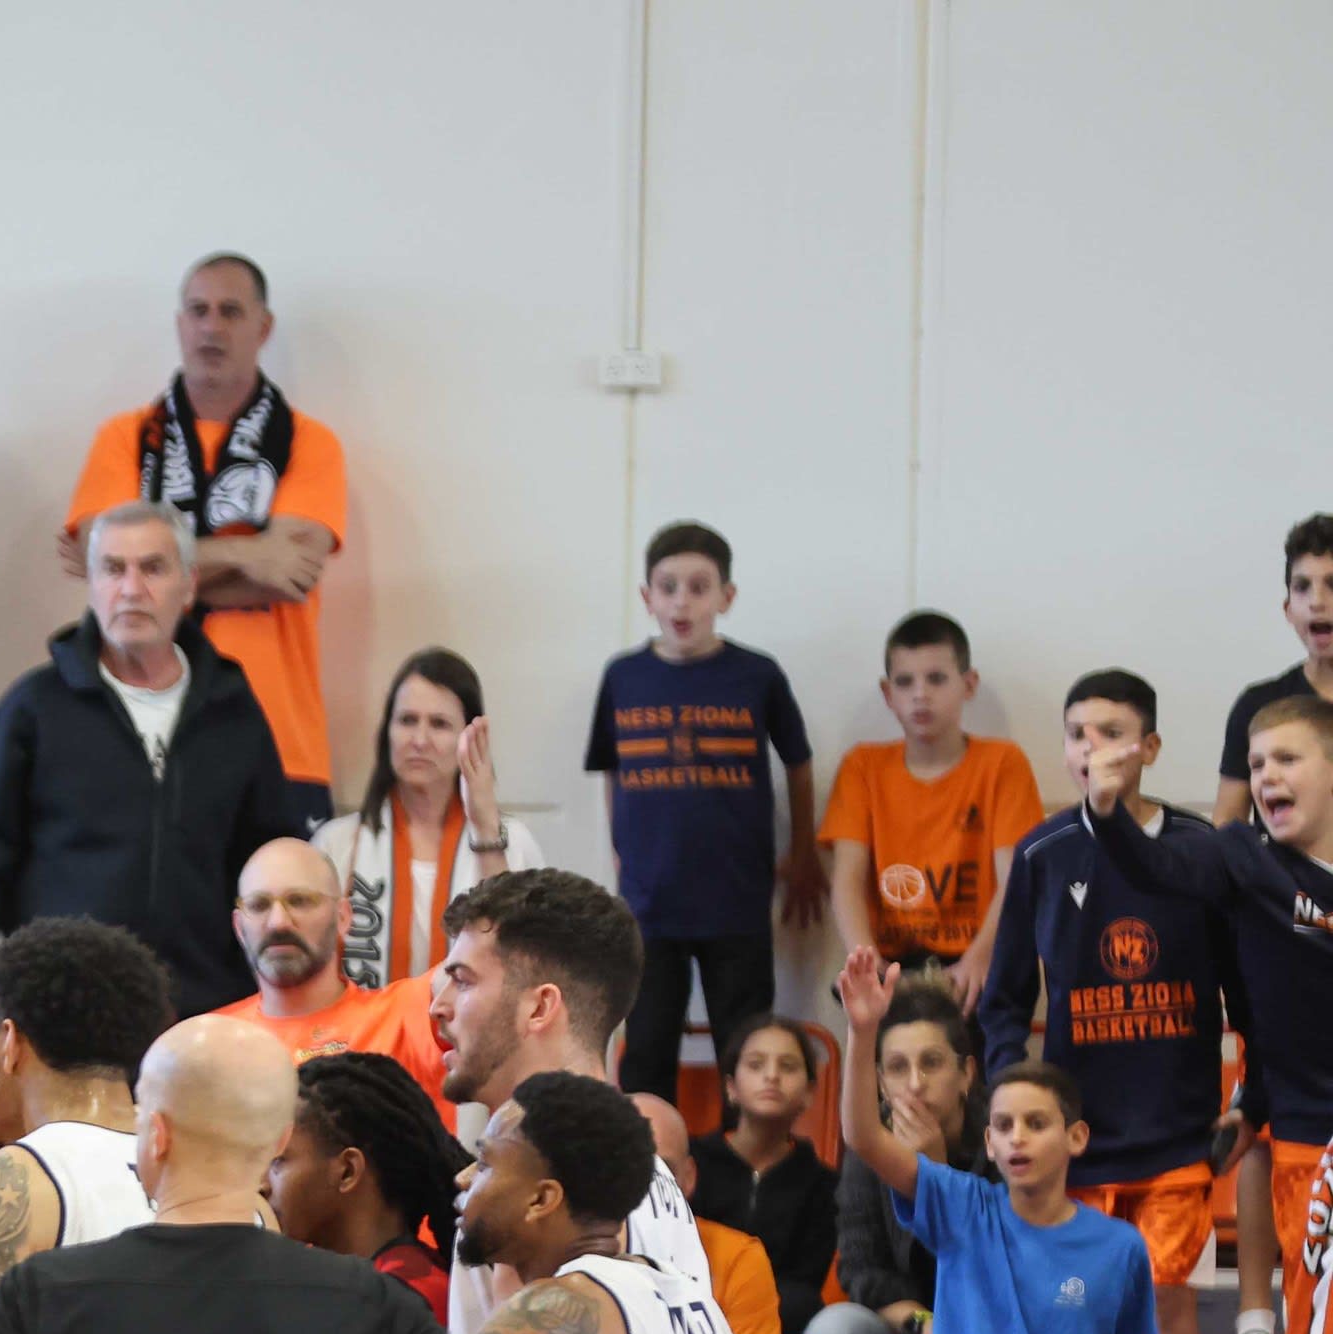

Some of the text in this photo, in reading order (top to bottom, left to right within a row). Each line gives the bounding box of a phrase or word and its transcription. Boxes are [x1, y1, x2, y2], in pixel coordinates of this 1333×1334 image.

[615, 704, 755, 729] NESS ZIONA
[1070, 981, 1196, 1014] NESS ZIONA
